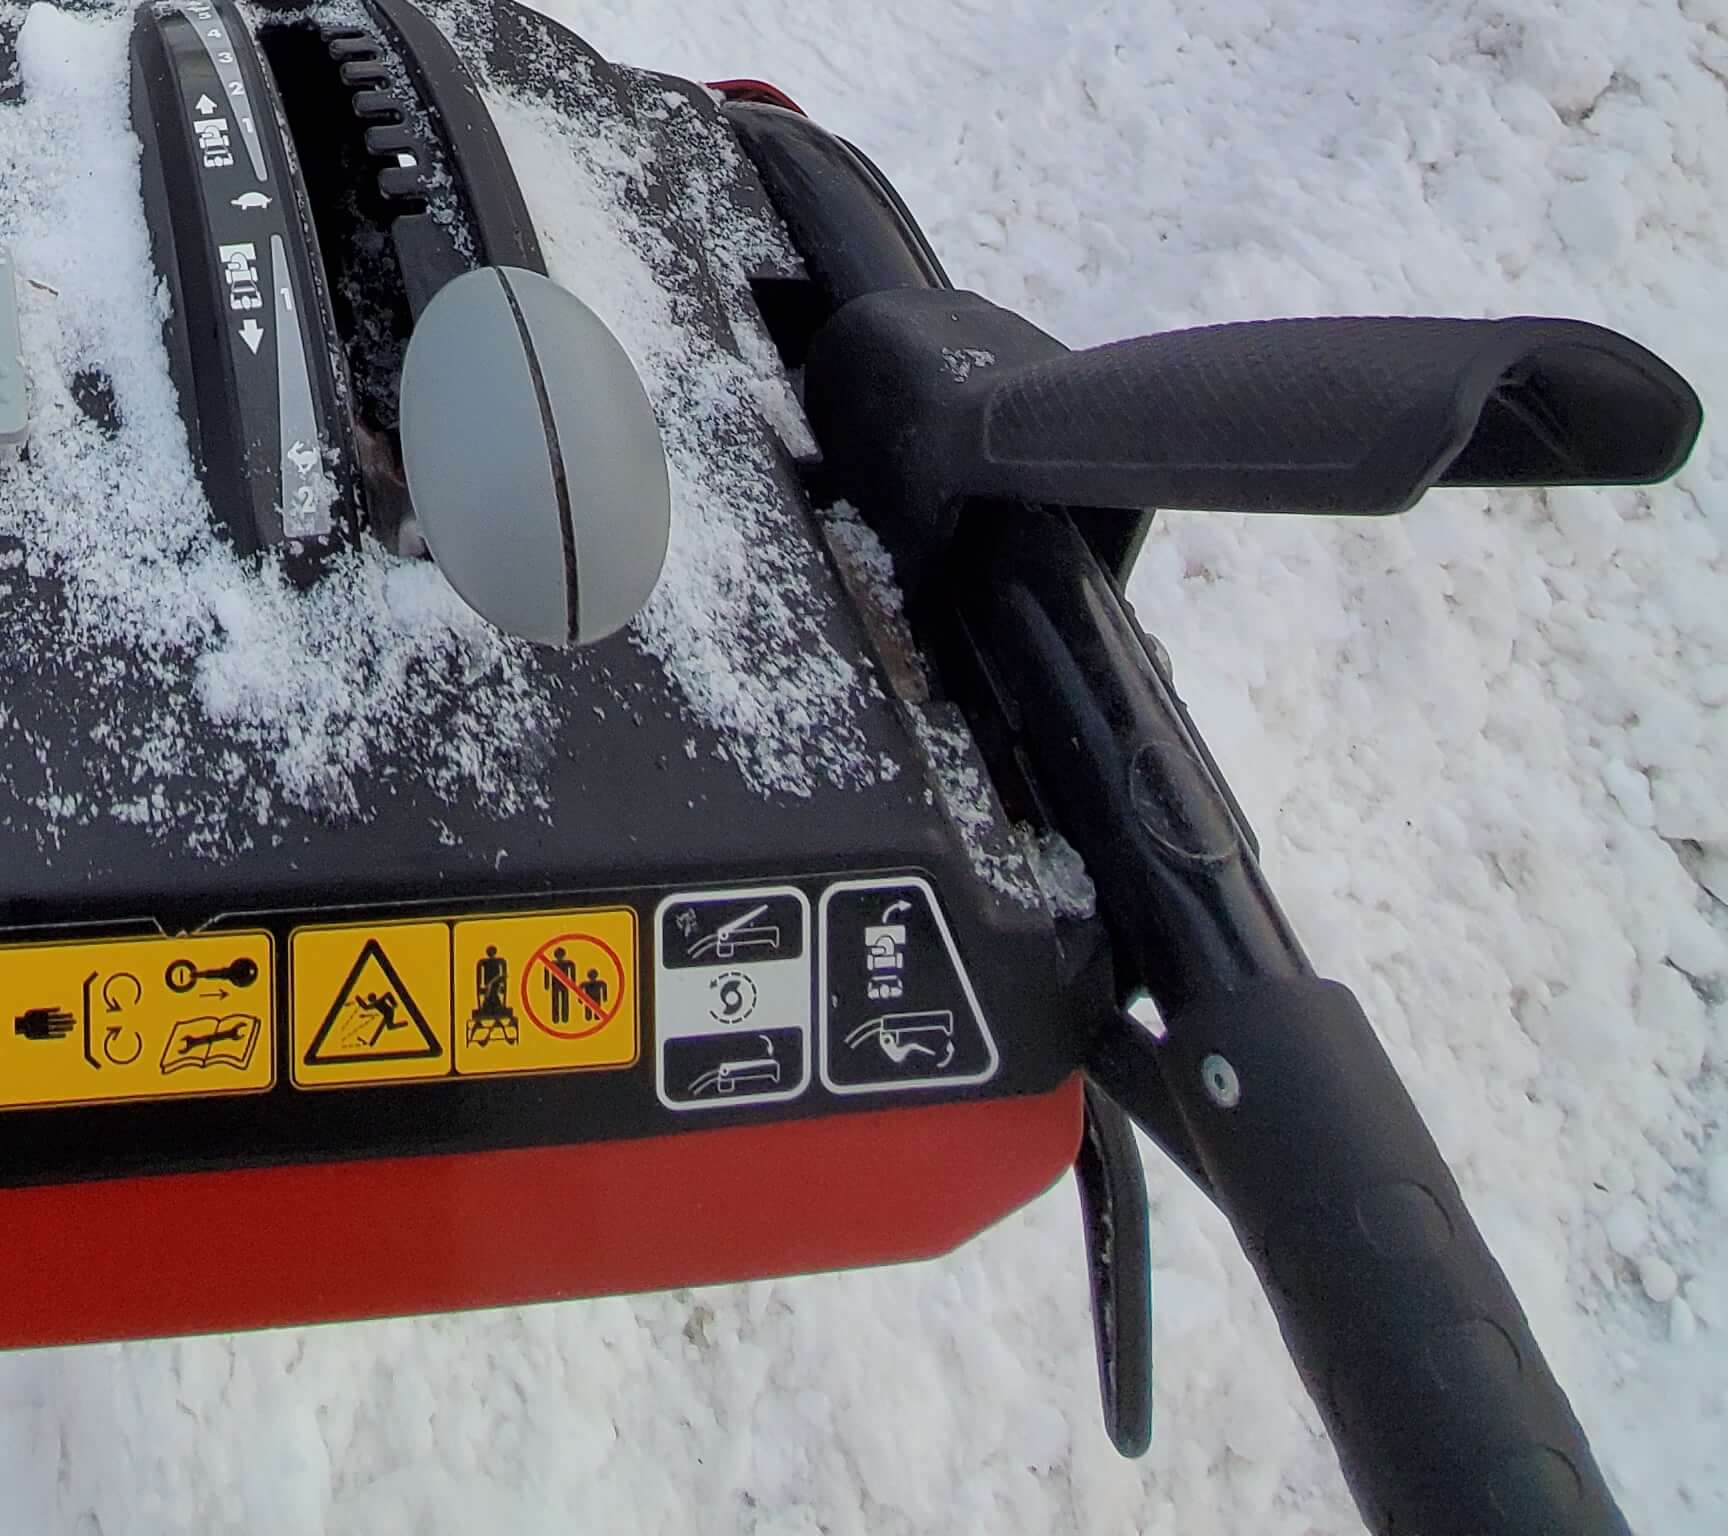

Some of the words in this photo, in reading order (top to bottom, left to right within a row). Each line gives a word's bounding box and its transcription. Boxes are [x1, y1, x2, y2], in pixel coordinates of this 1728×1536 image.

[207, 29, 222, 38] 4
[218, 51, 233, 63] 3
[228, 81, 244, 96] 2
[242, 117, 254, 133] 1
[280, 287, 292, 311] 1
[298, 486, 315, 513] 2
